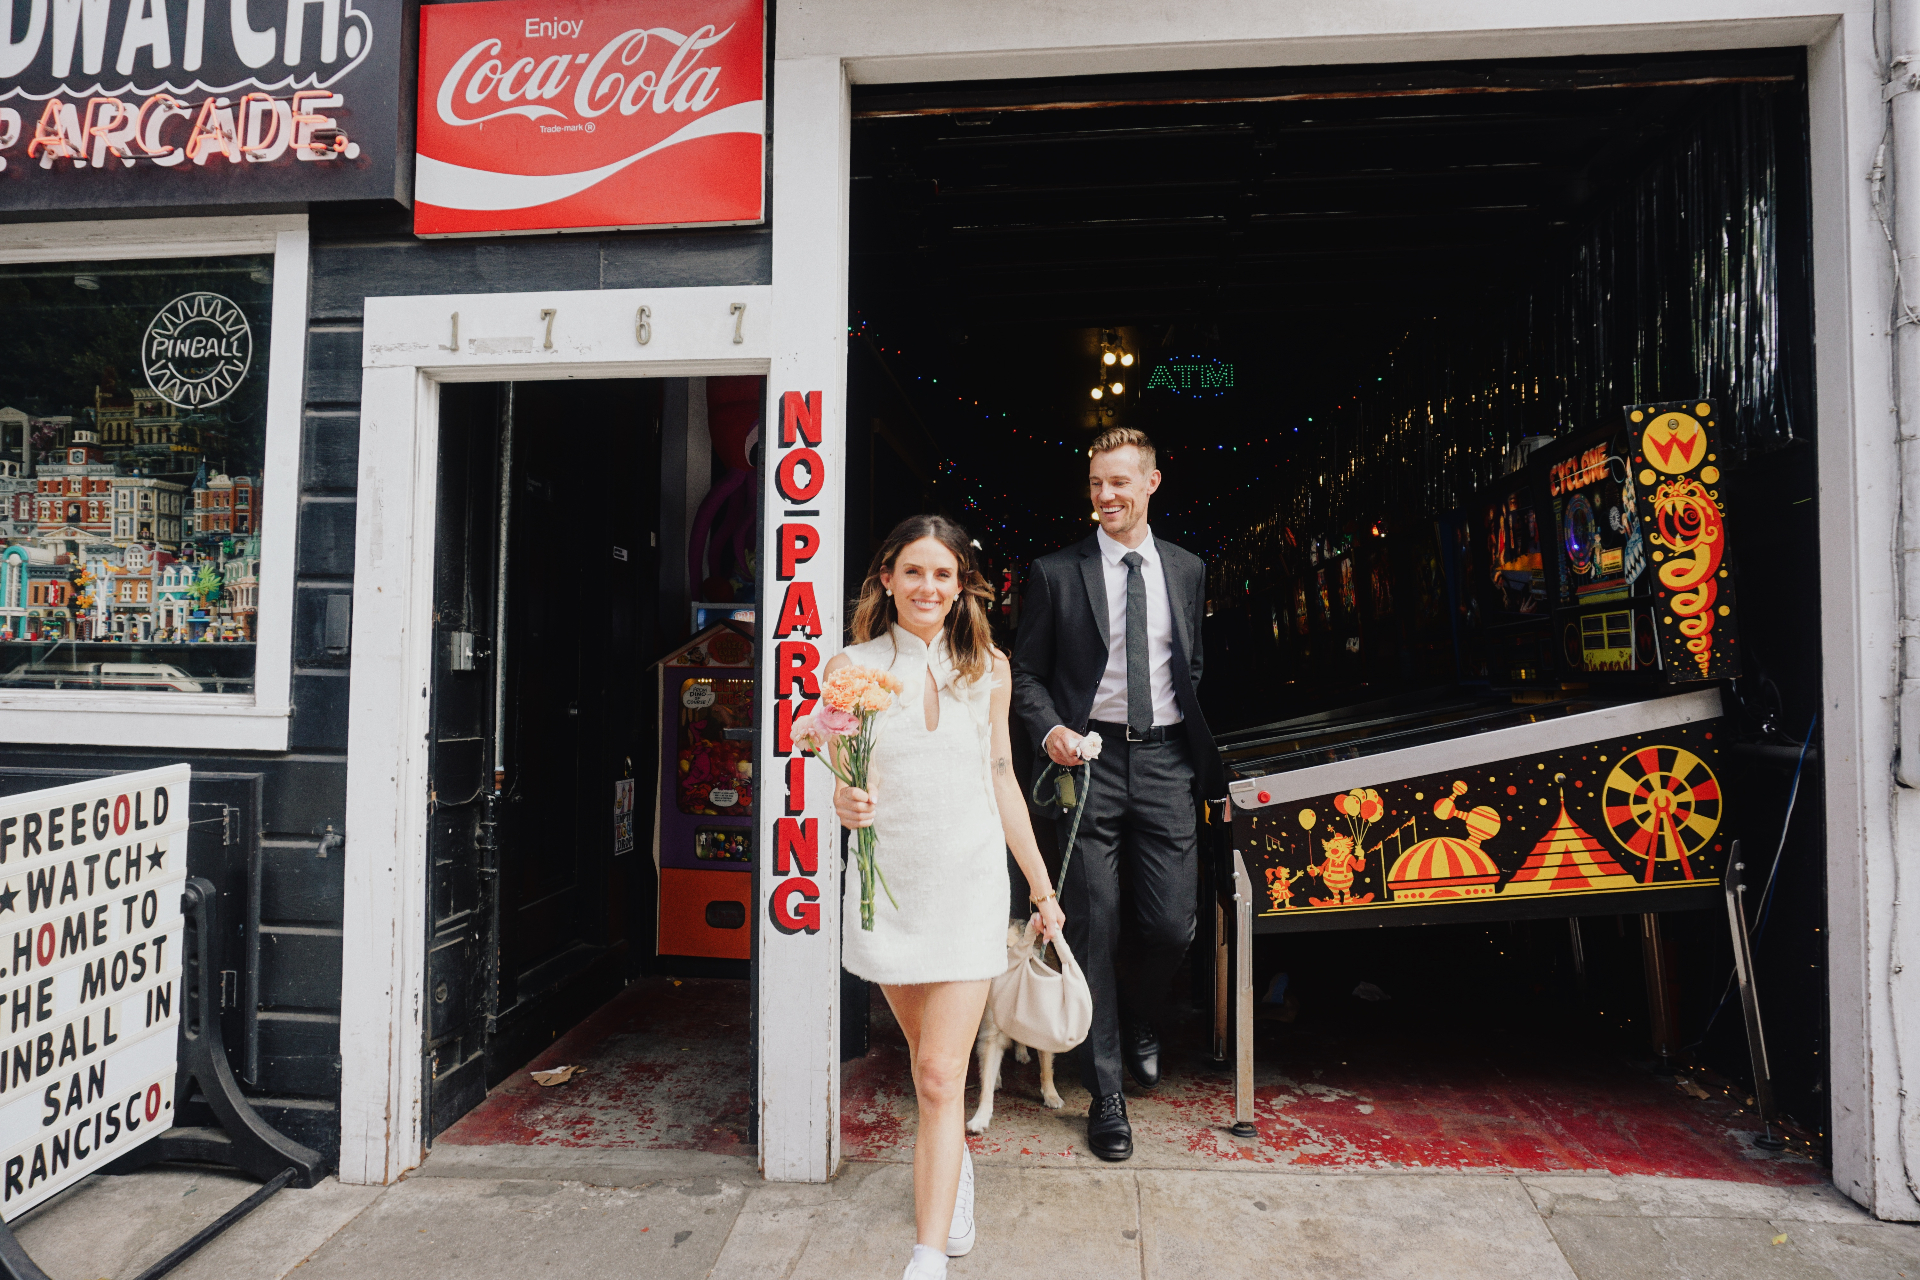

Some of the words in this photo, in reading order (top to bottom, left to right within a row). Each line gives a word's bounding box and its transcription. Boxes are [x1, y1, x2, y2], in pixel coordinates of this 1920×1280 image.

[525, 18, 583, 39] Enjoy
[437, 21, 737, 127] Coca-Cola
[540, 123, 583, 133] Trade-mark
[152, 336, 243, 360] PINBALL
[1146, 363, 1234, 389] ATM
[1550, 441, 1611, 497] CYCLONE
[0, 786, 169, 864] FREEGOLD
[26, 842, 142, 914] WATCH
[122, 888, 158, 935] TO
[80, 934, 168, 1004] MOST
[0, 1006, 118, 1094] INBALL
[145, 980, 172, 1028] IN
[42, 1059, 106, 1127] SAN
